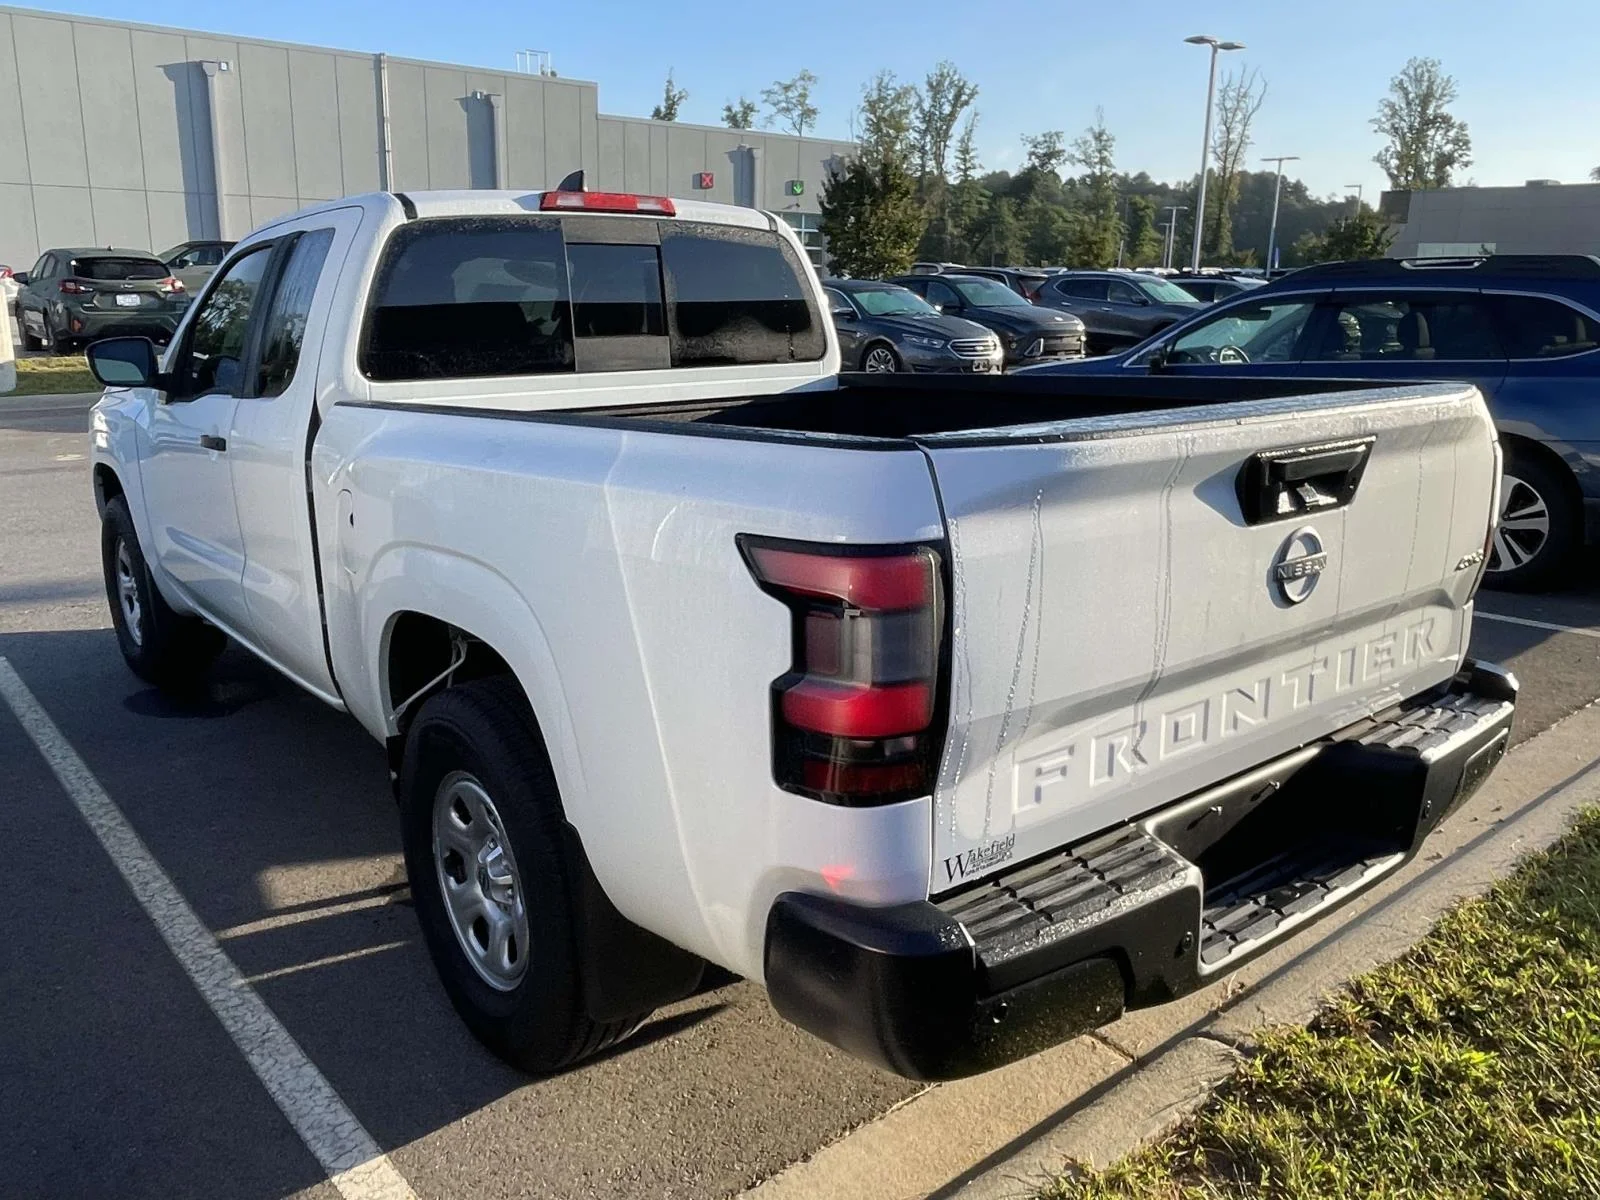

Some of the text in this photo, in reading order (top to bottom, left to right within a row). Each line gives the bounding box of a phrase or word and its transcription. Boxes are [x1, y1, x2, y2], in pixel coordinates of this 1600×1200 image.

[1277, 557, 1327, 580] NISSAN
[1012, 616, 1436, 814] FRONTIER
[943, 833, 1016, 883] Wakefield
